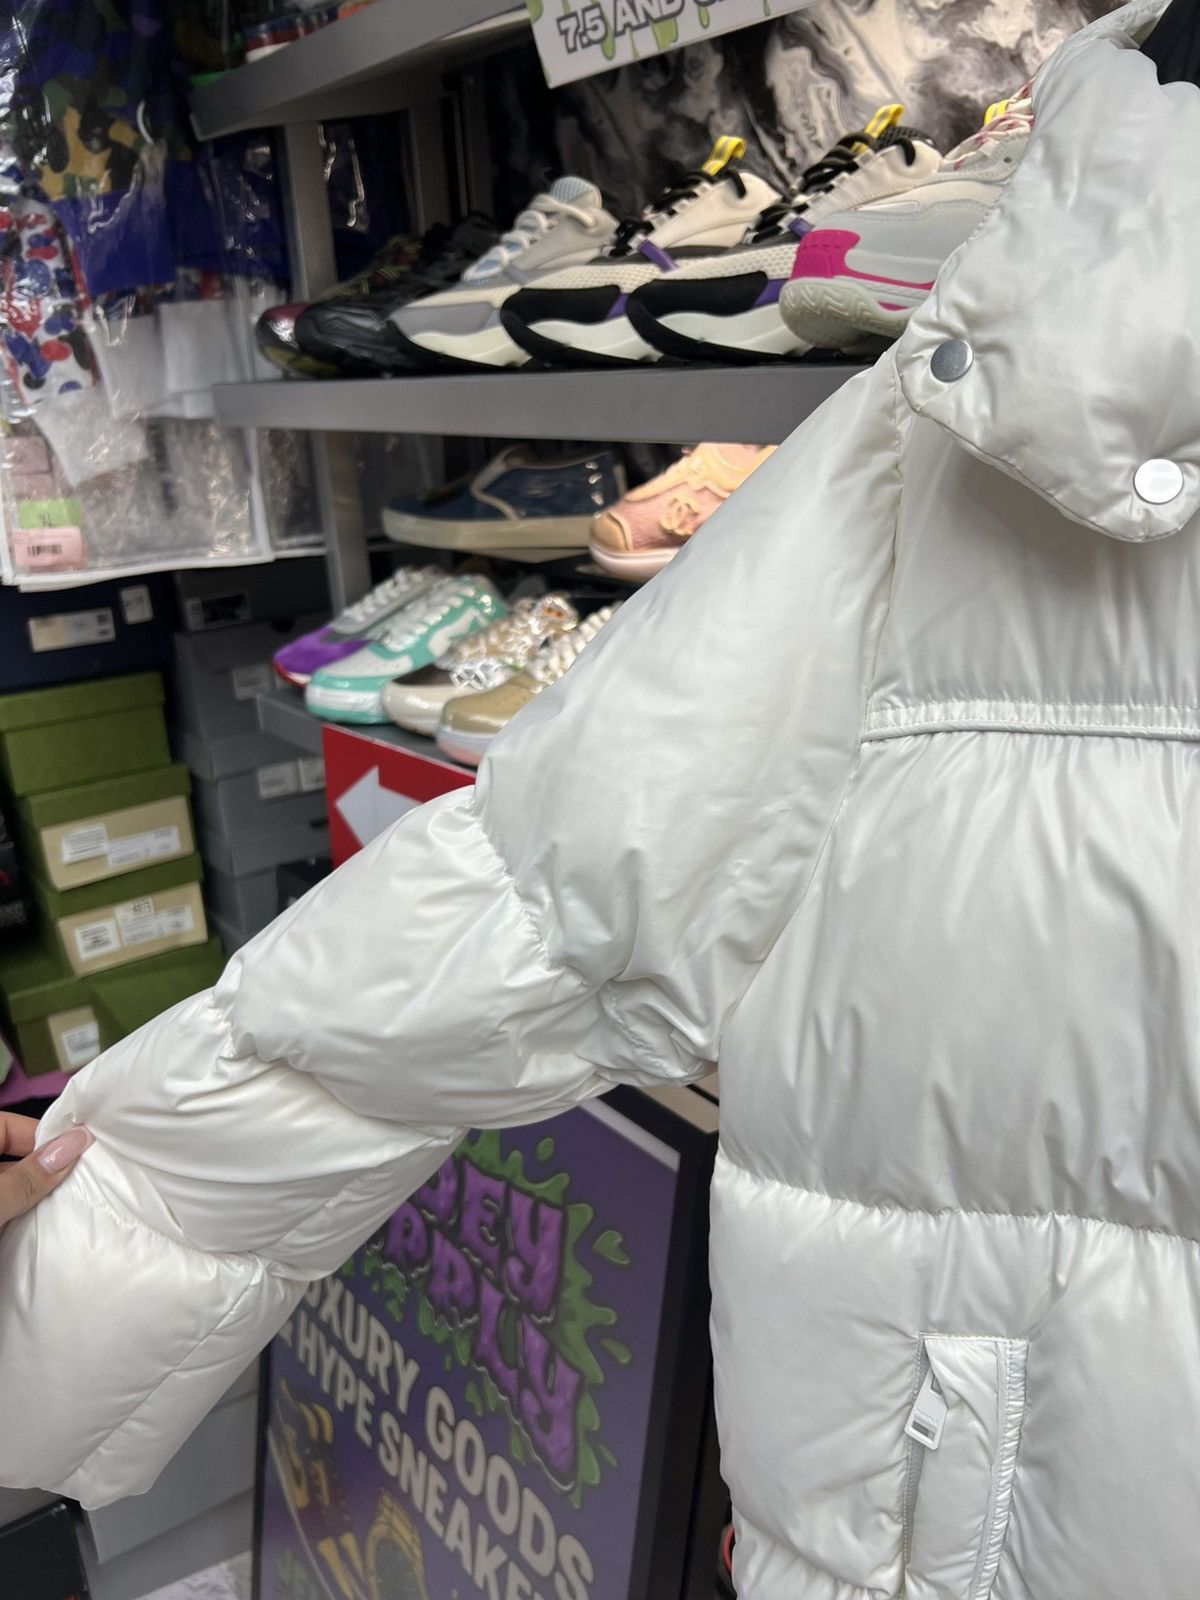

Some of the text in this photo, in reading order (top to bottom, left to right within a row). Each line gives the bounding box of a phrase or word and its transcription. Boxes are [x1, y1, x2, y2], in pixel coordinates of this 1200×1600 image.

[557, 0, 685, 53] 7.5 AND
[298, 1311, 377, 1447] HYPE
[307, 1276, 594, 1600] UXURY GOODS
